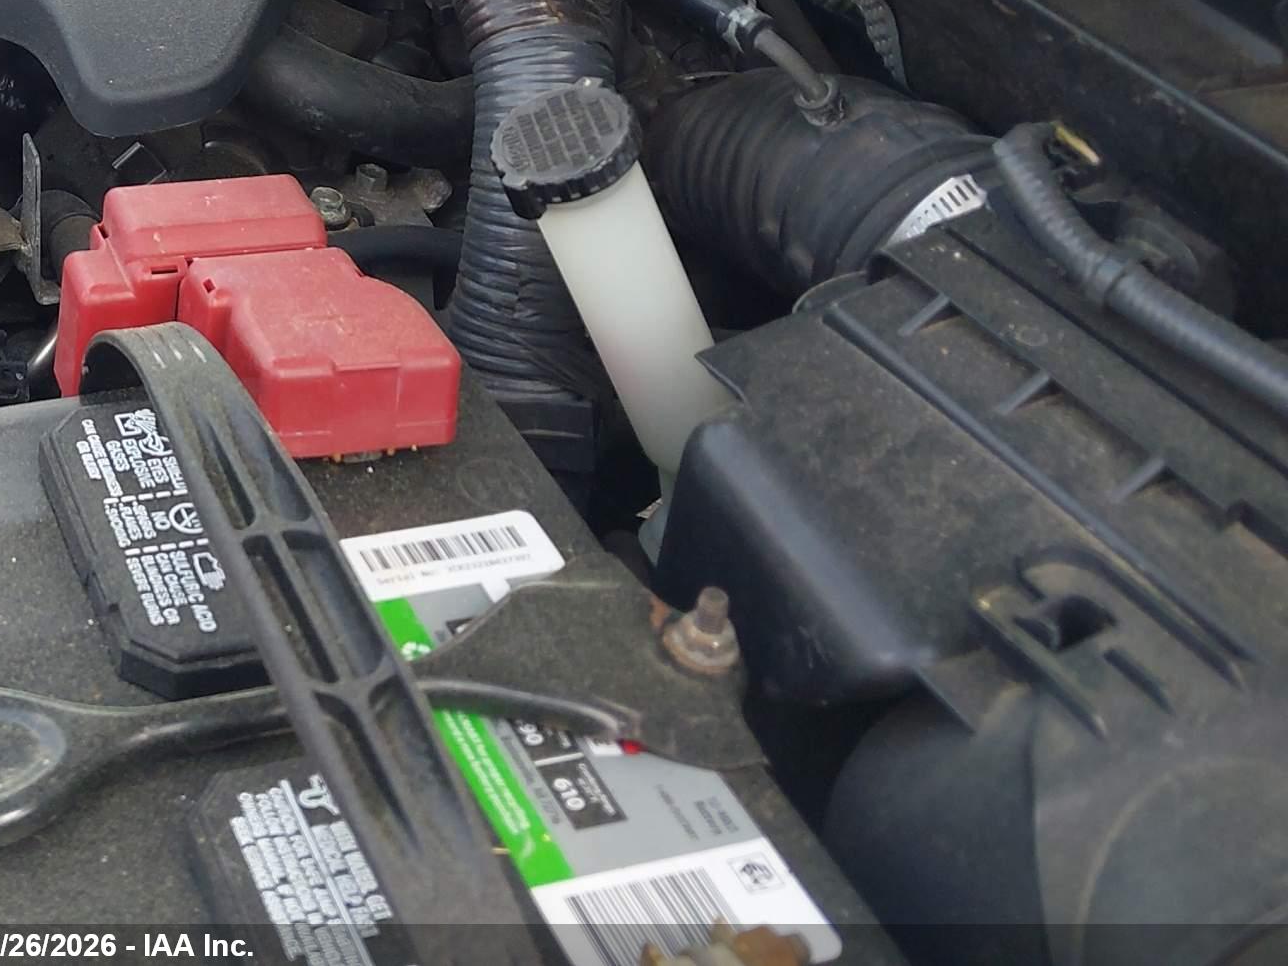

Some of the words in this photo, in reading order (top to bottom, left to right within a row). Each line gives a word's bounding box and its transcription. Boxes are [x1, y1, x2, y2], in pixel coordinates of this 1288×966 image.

[105, 440, 131, 472] GASES
[121, 438, 156, 489] EXPLOSIVE
[147, 457, 170, 484] EYES
[150, 511, 172, 531] NO
[125, 556, 152, 592] SEVERE
[155, 552, 174, 574] CAN
[140, 554, 173, 607] BLINDNESS
[162, 607, 181, 626] OR
[163, 573, 189, 607] CAUSE
[169, 549, 205, 604] SULFURIC
[191, 604, 218, 632] ACID
[552, 777, 586, 812] 610
